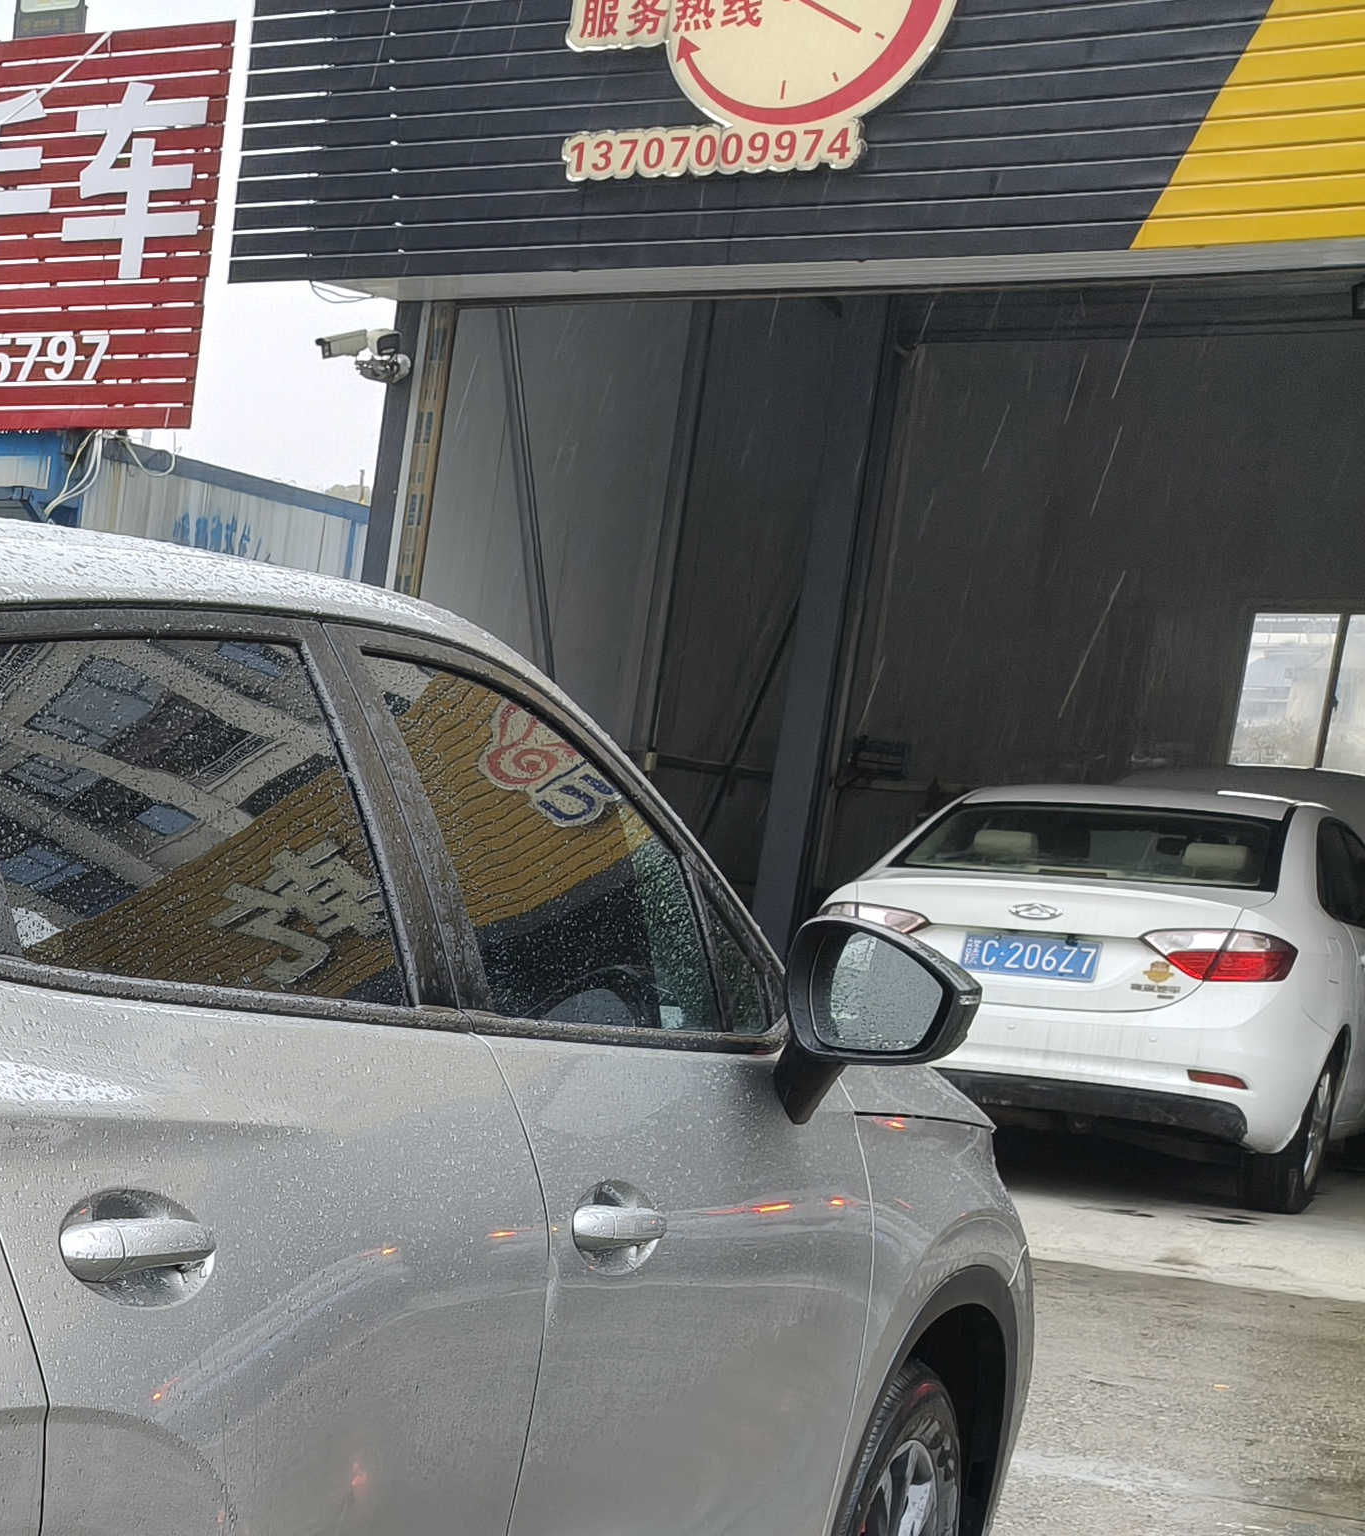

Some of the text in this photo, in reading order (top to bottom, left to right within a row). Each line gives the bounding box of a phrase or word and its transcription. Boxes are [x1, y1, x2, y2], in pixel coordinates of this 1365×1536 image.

[579, 0, 763, 38] 服务热线
[569, 126, 851, 174] 13707009974
